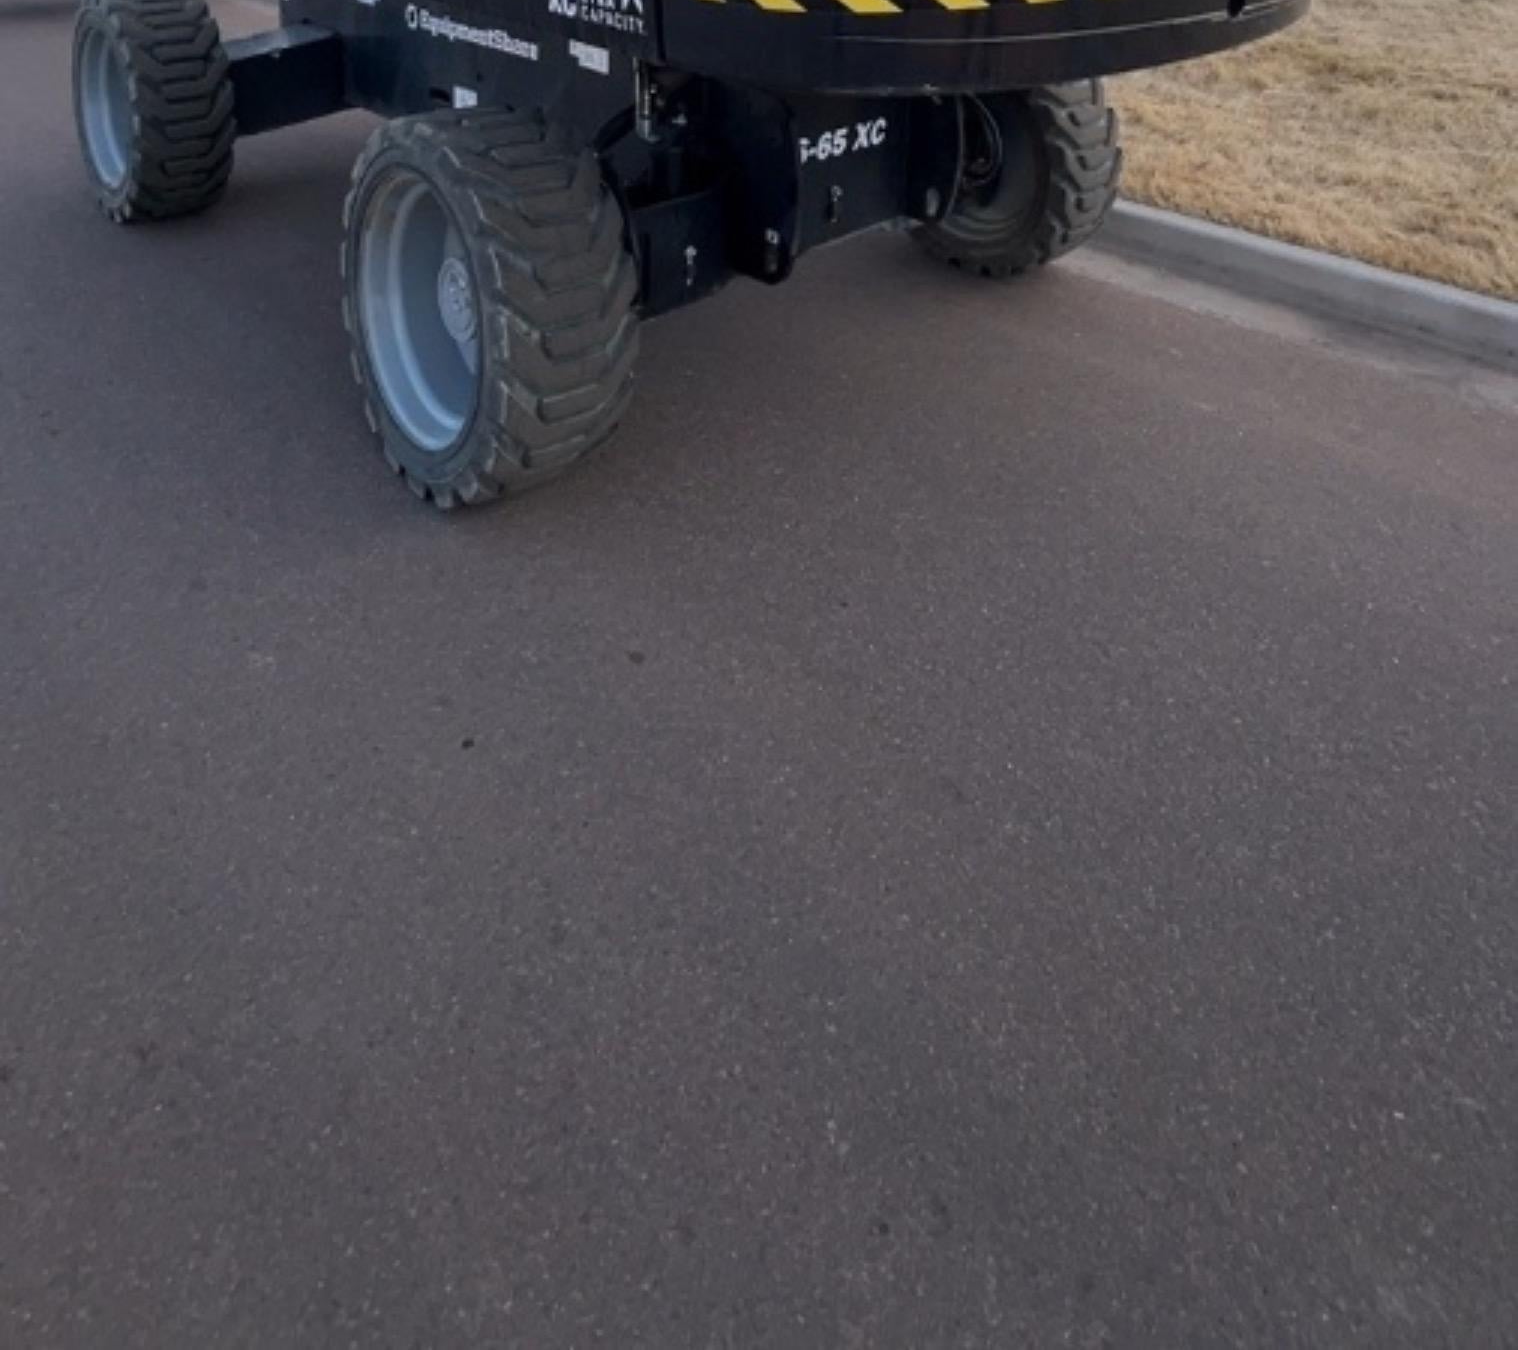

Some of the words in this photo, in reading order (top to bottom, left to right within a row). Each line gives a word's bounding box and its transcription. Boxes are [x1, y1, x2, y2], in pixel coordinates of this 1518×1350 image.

[420, 10, 539, 62] EquipmentShare
[581, 4, 646, 34] CAPACITY
[852, 116, 887, 151] XC
